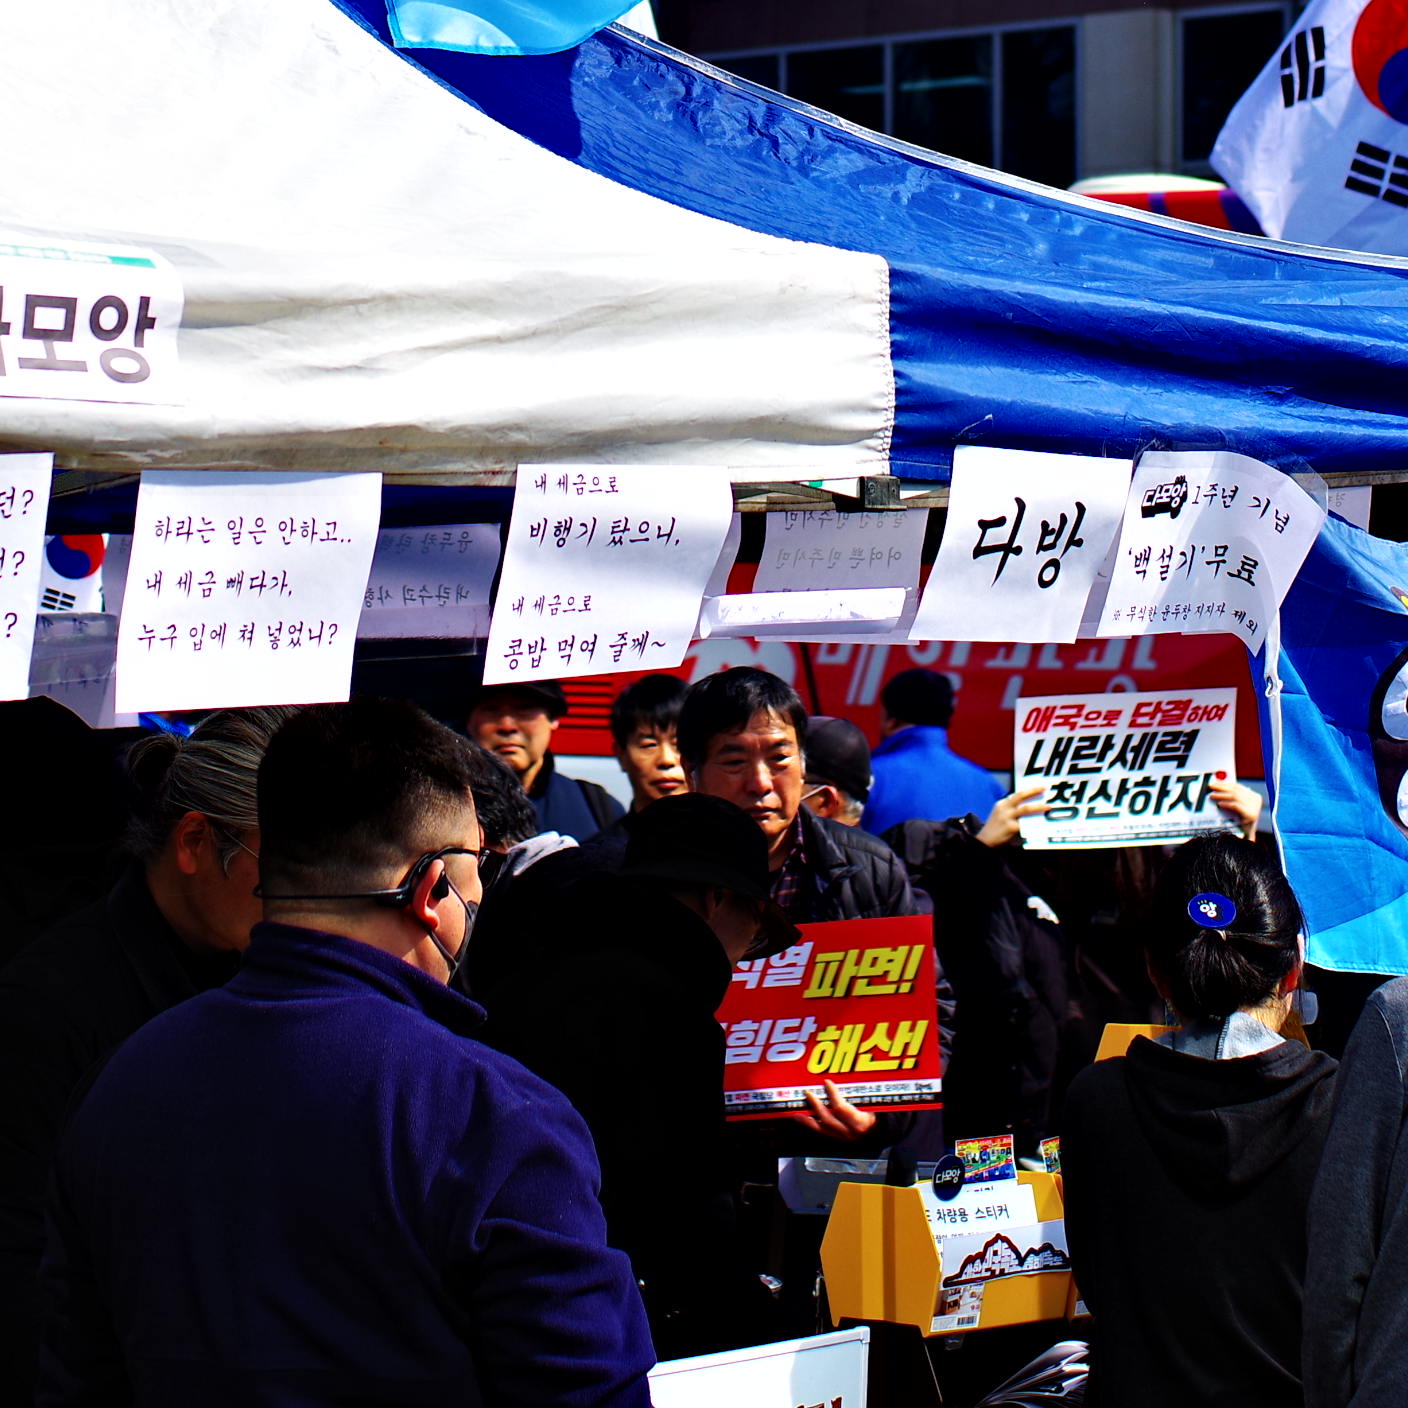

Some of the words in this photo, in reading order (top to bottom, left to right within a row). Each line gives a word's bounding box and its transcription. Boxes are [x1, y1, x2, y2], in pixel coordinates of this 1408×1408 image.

[535, 473, 547, 495] 내
[557, 473, 619, 495] 세금으로
[1141, 478, 1188, 512] 다모앙
[1191, 483, 1240, 510] 1주년
[1248, 495, 1294, 535] 기념
[155, 516, 215, 545] 하라는
[227, 516, 267, 545] 일은
[278, 517, 352, 545] 안하고..
[529, 516, 597, 549] 비행기
[606, 516, 681, 547] 탔으니,
[971, 496, 1087, 589] 다방
[146, 570, 163, 597] 내
[176, 569, 216, 598] 세금
[226, 569, 293, 597] 빼다가,
[512, 596, 524, 616] 내
[532, 594, 592, 616] 세금으로
[1126, 605, 1158, 623] 무식한
[1161, 603, 1191, 622] 윤두창
[1195, 602, 1226, 619] 지지자
[1232, 609, 1258, 636] 제외
[137, 624, 177, 652] 누구
[189, 622, 227, 652] 입에
[238, 621, 256, 649] 쳐
[267, 620, 339, 650] 넣었니?
[503, 636, 547, 670] 콩밥
[557, 634, 598, 667] 먹여
[1022, 703, 1124, 733] 애국으로
[1127, 698, 1230, 729] 단결하여
[1023, 728, 1201, 777] 내란세력
[1043, 772, 1216, 822] 청산하자
[802, 944, 926, 998] 파면!
[806, 1020, 929, 1074] 해산!
[935, 1165, 961, 1184] 다모앙
[936, 1208, 969, 1223] 차량용
[975, 1204, 1010, 1220] 스티커
